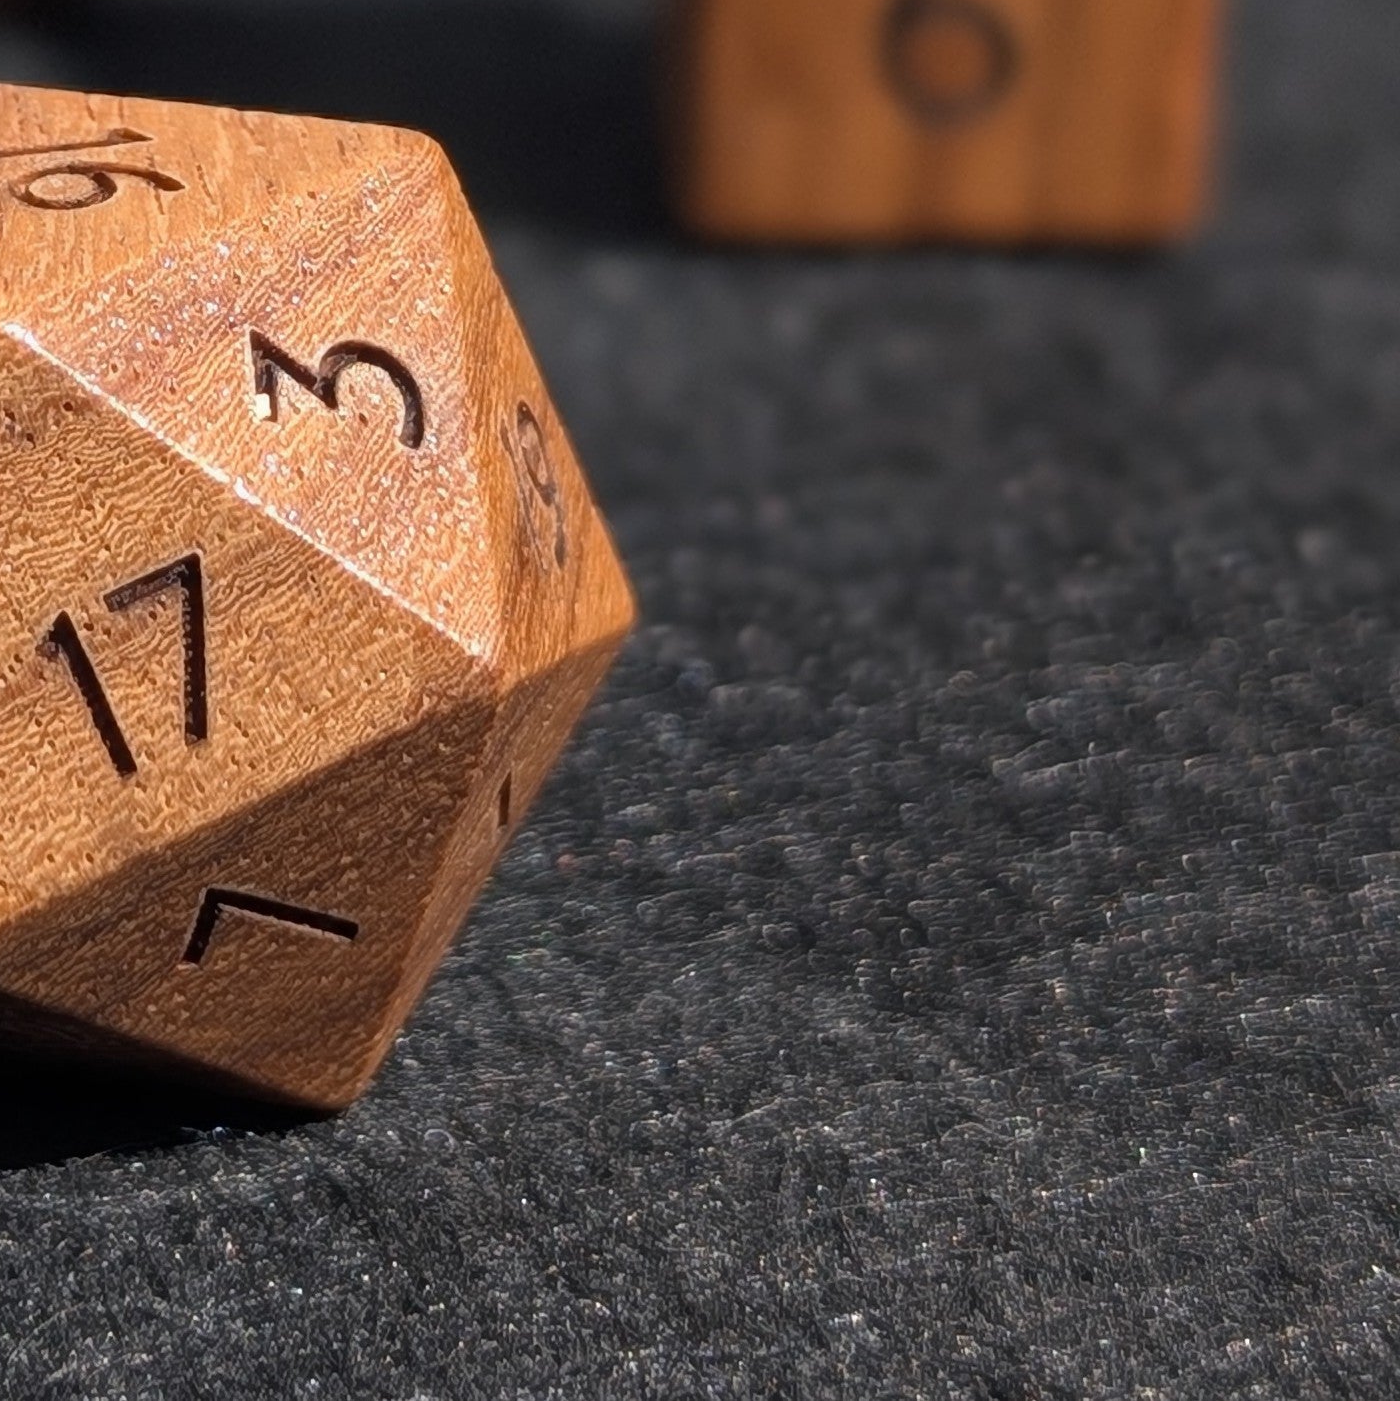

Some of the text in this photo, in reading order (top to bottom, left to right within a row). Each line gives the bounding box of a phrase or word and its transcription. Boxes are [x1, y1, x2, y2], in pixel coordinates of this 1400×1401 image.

[248, 328, 426, 451] 3
[36, 551, 209, 777] 17
[179, 886, 361, 968] 7
